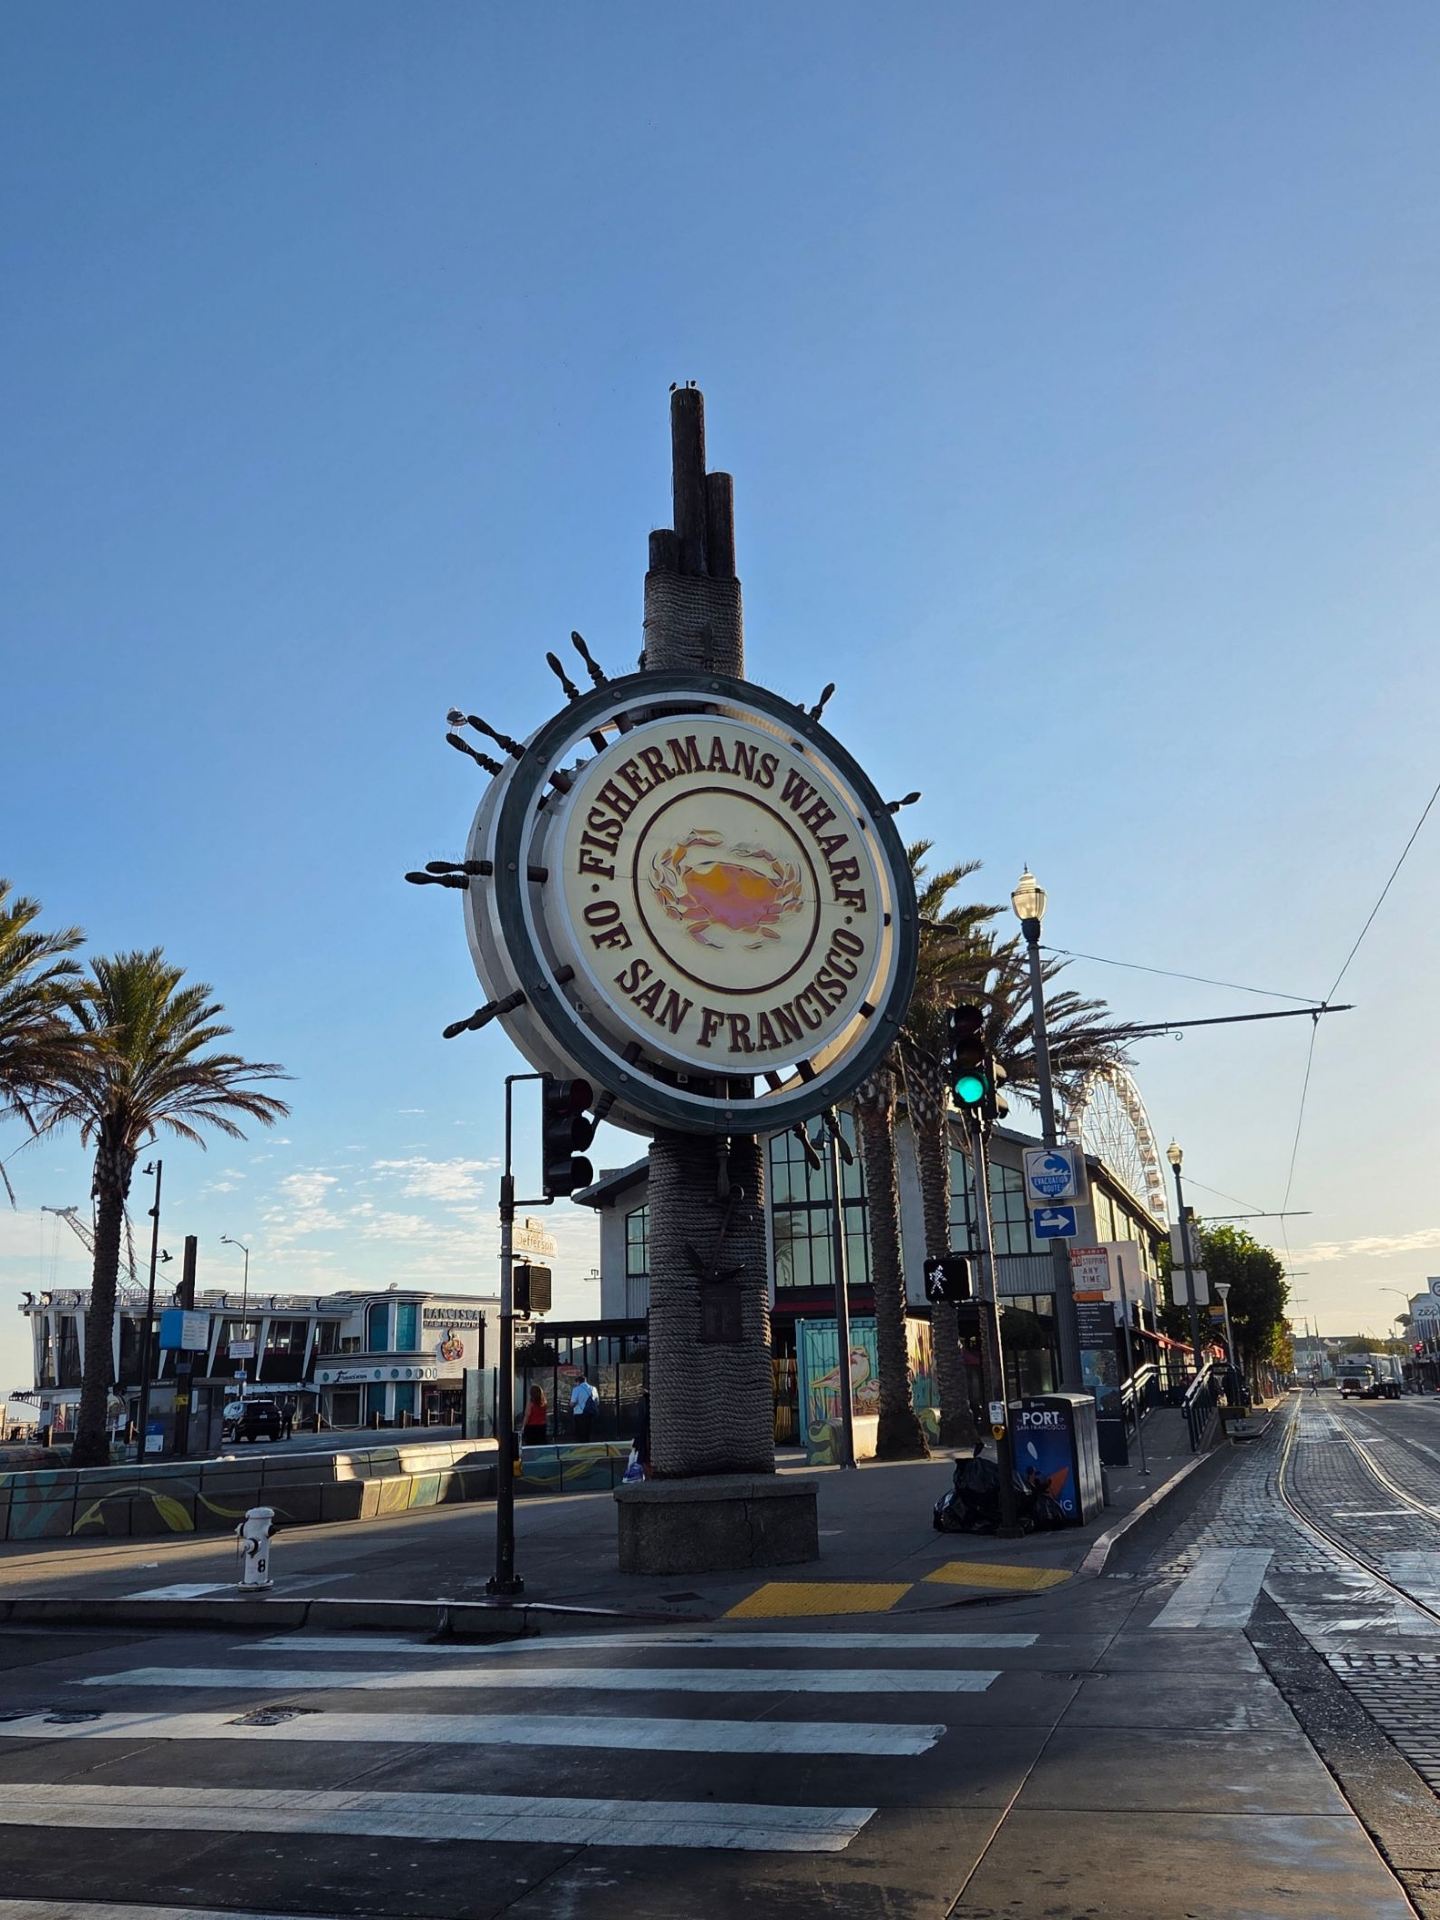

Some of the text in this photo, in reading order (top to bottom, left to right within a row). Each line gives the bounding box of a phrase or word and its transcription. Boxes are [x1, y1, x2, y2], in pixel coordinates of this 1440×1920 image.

[578, 735, 867, 913] FISHERMANS WHARF
[583, 900, 866, 1053] OF SAN FRANCISCO
[1033, 1175, 1069, 1186] EVACUATION
[1042, 1184, 1061, 1193] ROUTE
[516, 1234, 554, 1251] Jefferson
[1082, 1275, 1101, 1283] TIME
[1022, 1411, 1060, 1426] PORT
[257, 1559, 266, 1573] 8
